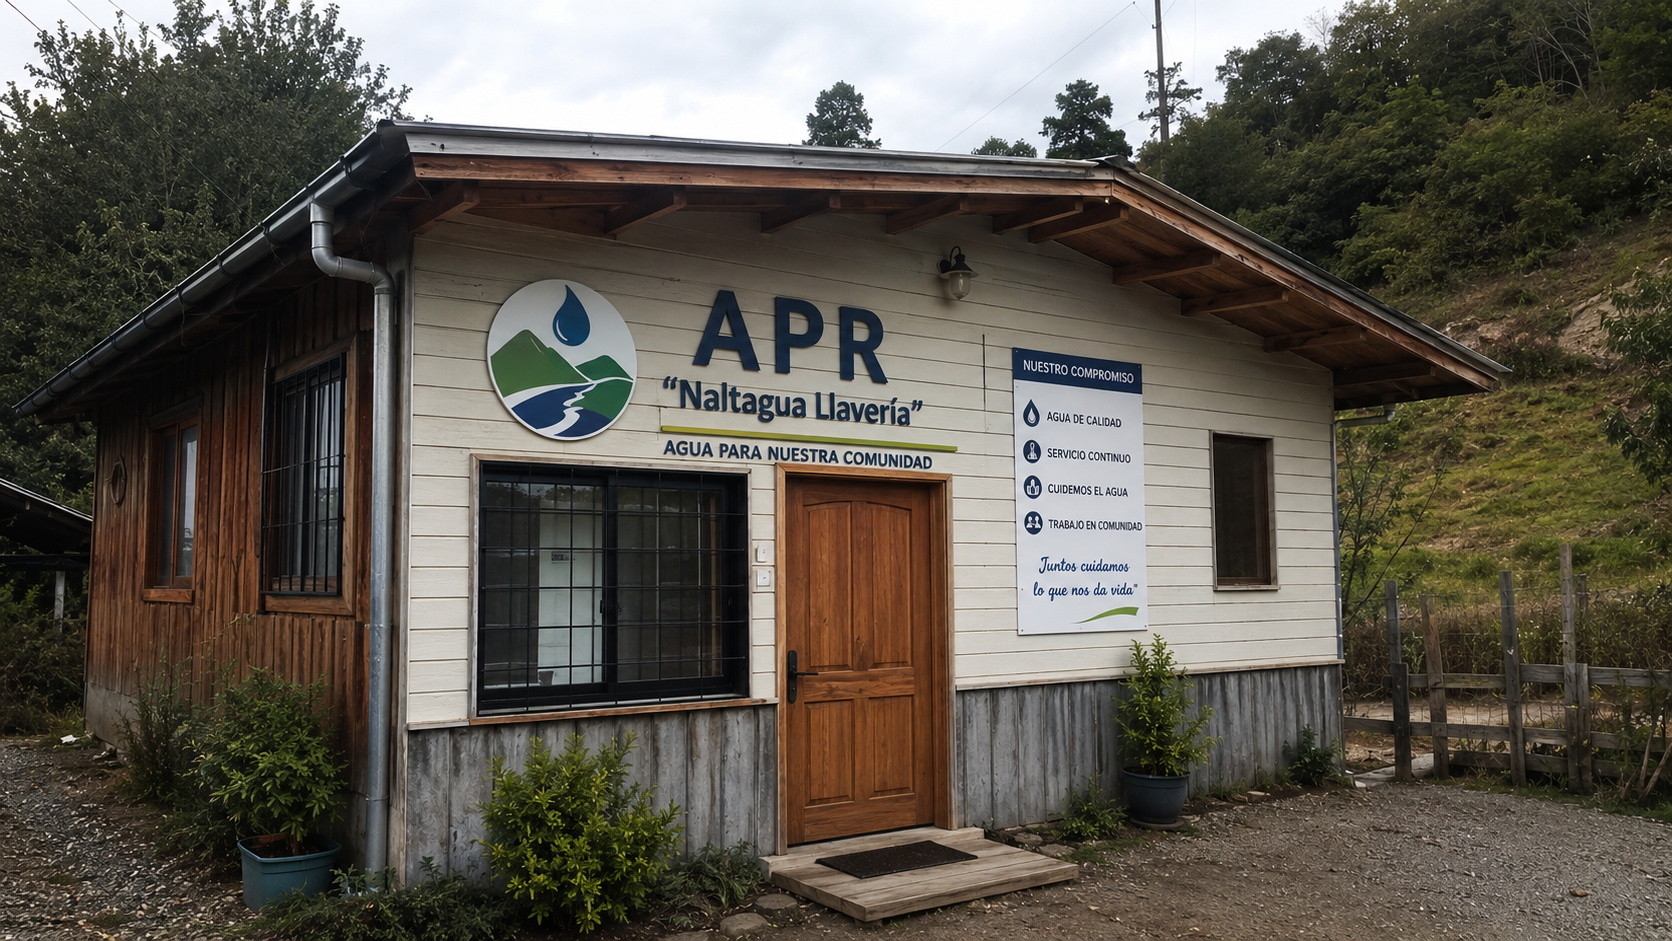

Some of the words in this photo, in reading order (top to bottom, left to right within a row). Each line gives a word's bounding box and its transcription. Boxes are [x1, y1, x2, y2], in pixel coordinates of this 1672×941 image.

[692, 290, 888, 384] APR
[1023, 359, 1068, 376] NUESTRO
[1071, 366, 1134, 383] COMPROMISO
[662, 376, 807, 422] “Naltagua
[815, 392, 923, 427] Llavería”
[1047, 412, 1071, 424] AGUA
[1073, 415, 1084, 425] DE
[1086, 416, 1122, 428] CALIDAD
[663, 440, 713, 457] AGUA
[719, 443, 762, 461] PARA
[768, 447, 838, 464] NUESTRA
[843, 450, 933, 470] COMUNIDAD
[1047, 448, 1086, 460] SERVICIO
[1088, 452, 1131, 464] CONTINUO
[1048, 484, 1092, 496] CUIDEMOS
[1094, 487, 1104, 497] EL
[1105, 487, 1129, 497] AGUA
[1048, 519, 1084, 530] TRABAJO
[1086, 521, 1097, 530] EN
[1098, 521, 1143, 531] COMUNIDAD
[1039, 556, 1077, 574] Juntos
[1080, 559, 1130, 572] cuidamos
[1033, 582, 1045, 596] lo
[1048, 586, 1068, 602] que
[1071, 587, 1090, 596] nos
[1093, 582, 1108, 596] da
